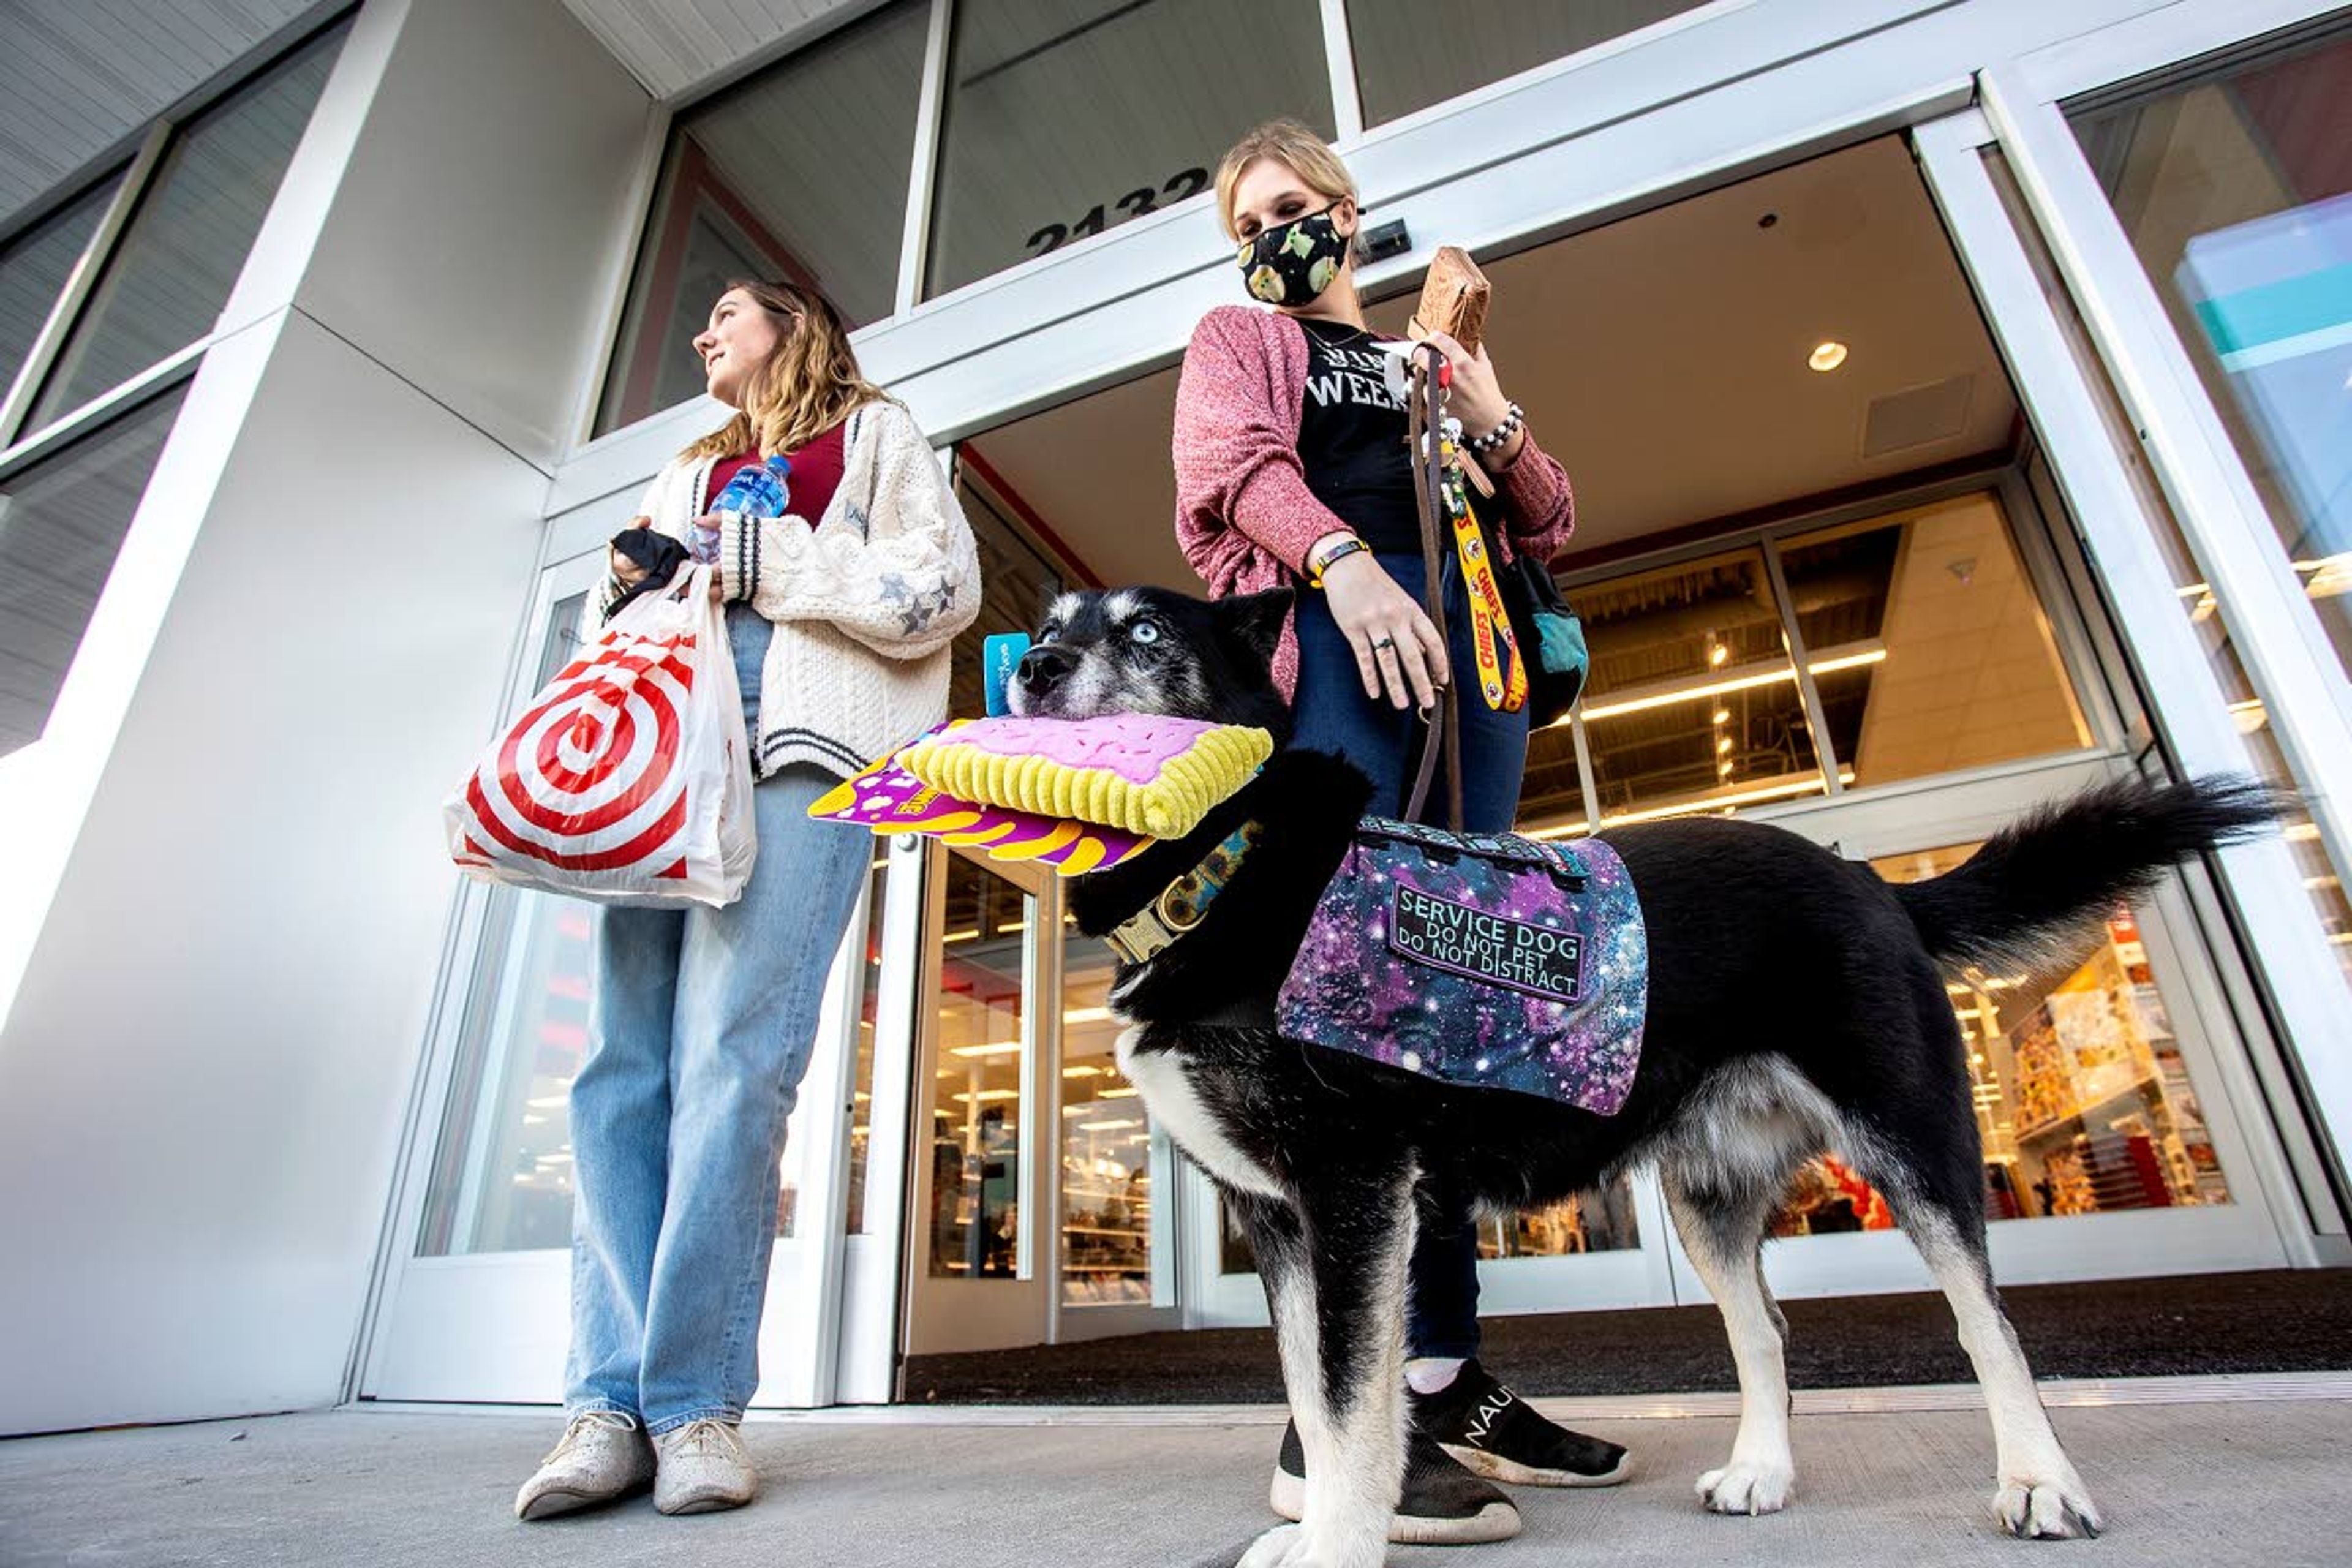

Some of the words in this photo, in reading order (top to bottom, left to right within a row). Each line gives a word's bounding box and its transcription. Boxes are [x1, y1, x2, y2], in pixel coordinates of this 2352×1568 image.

[1477, 567, 1502, 619] CHIEFS
[1475, 609, 1494, 669] CHIEFS
[1400, 890, 1506, 942] SERVICE
[1517, 928, 1577, 960] DOG
[1427, 922, 1456, 944] DO
[1463, 934, 1504, 956] NOT
[1512, 946, 1547, 970] PET
[1398, 927, 1425, 951] DO
[1432, 940, 1475, 967] NOT
[1480, 954, 1577, 995] DISTRACT
